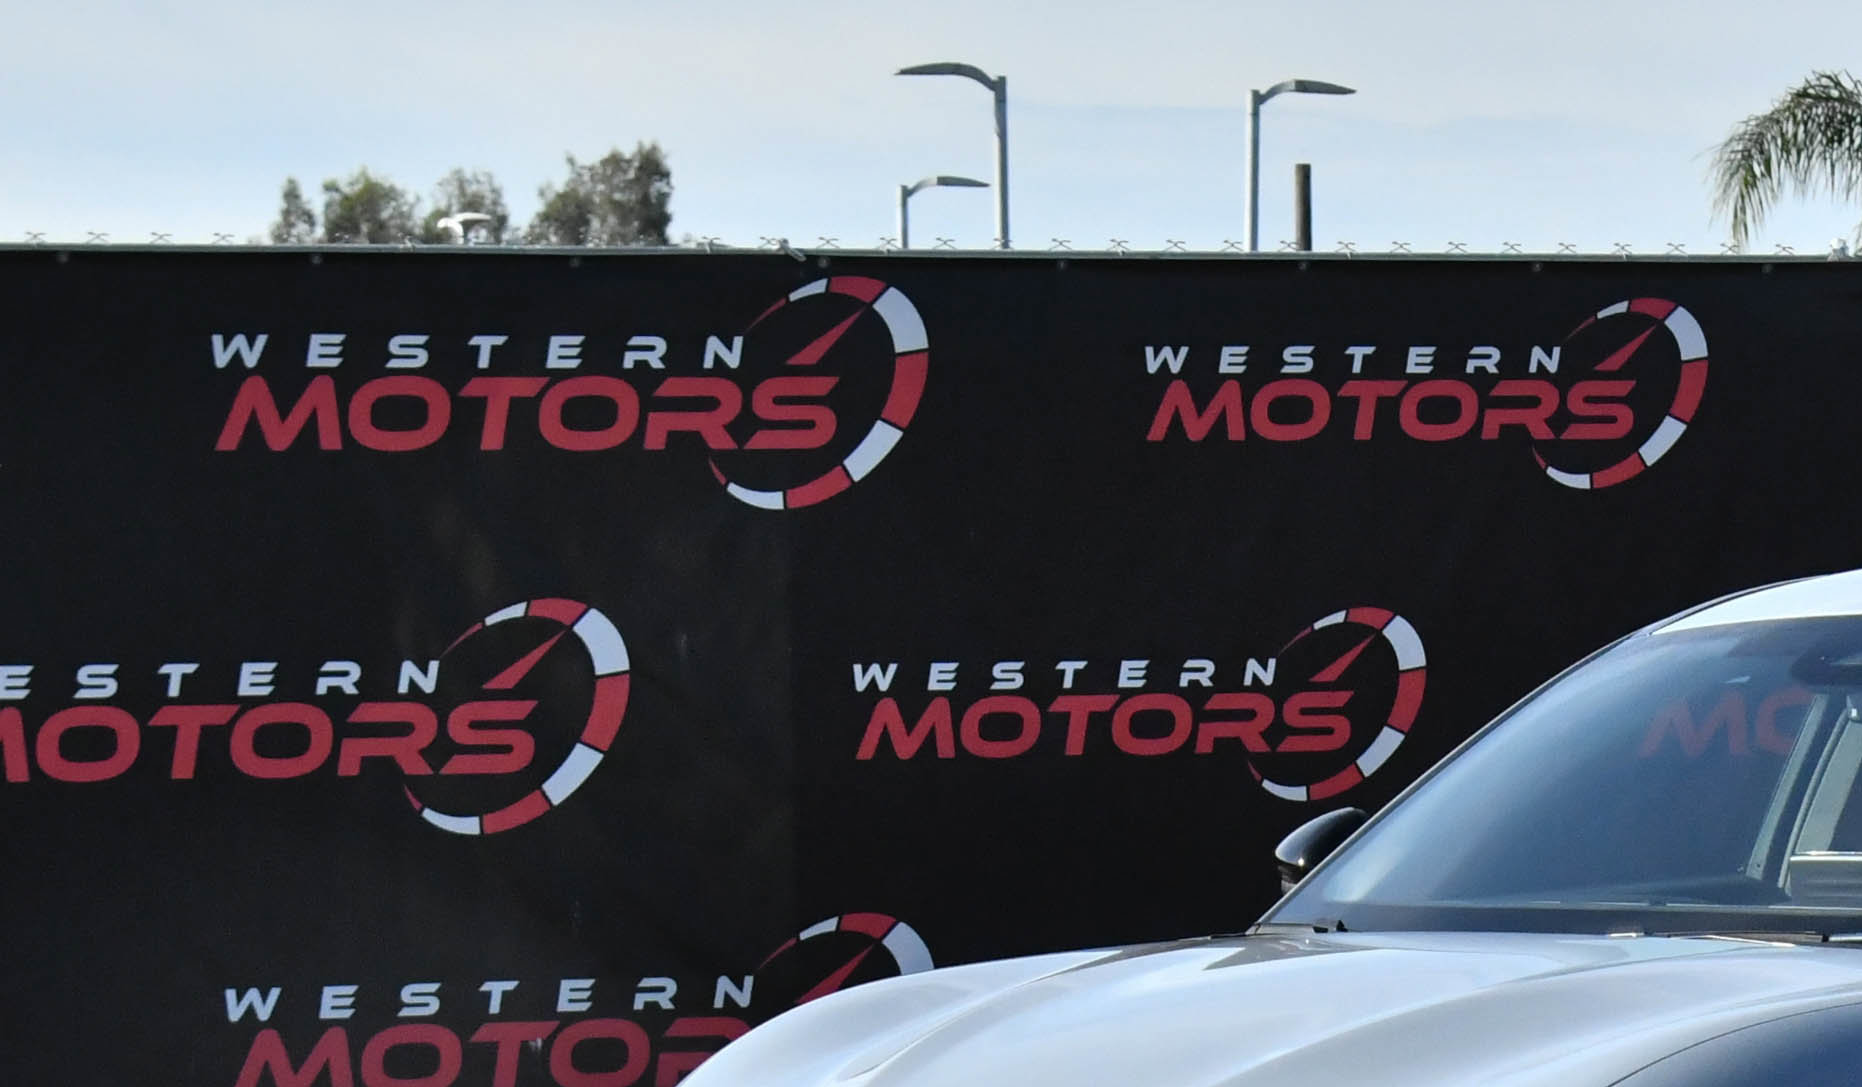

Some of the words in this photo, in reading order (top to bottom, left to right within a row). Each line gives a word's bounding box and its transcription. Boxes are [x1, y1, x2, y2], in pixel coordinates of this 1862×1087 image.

[213, 335, 743, 369] WESTERN
[1146, 346, 1560, 374] WESTERN
[215, 376, 839, 452] MOTORS
[1147, 379, 1636, 441] MOTORS
[0, 661, 439, 699] ESTERN
[853, 659, 1276, 692] WESTERN
[0, 701, 538, 782] OTORS
[855, 691, 1354, 760] MOTORS
[226, 975, 753, 1022] WESTERN
